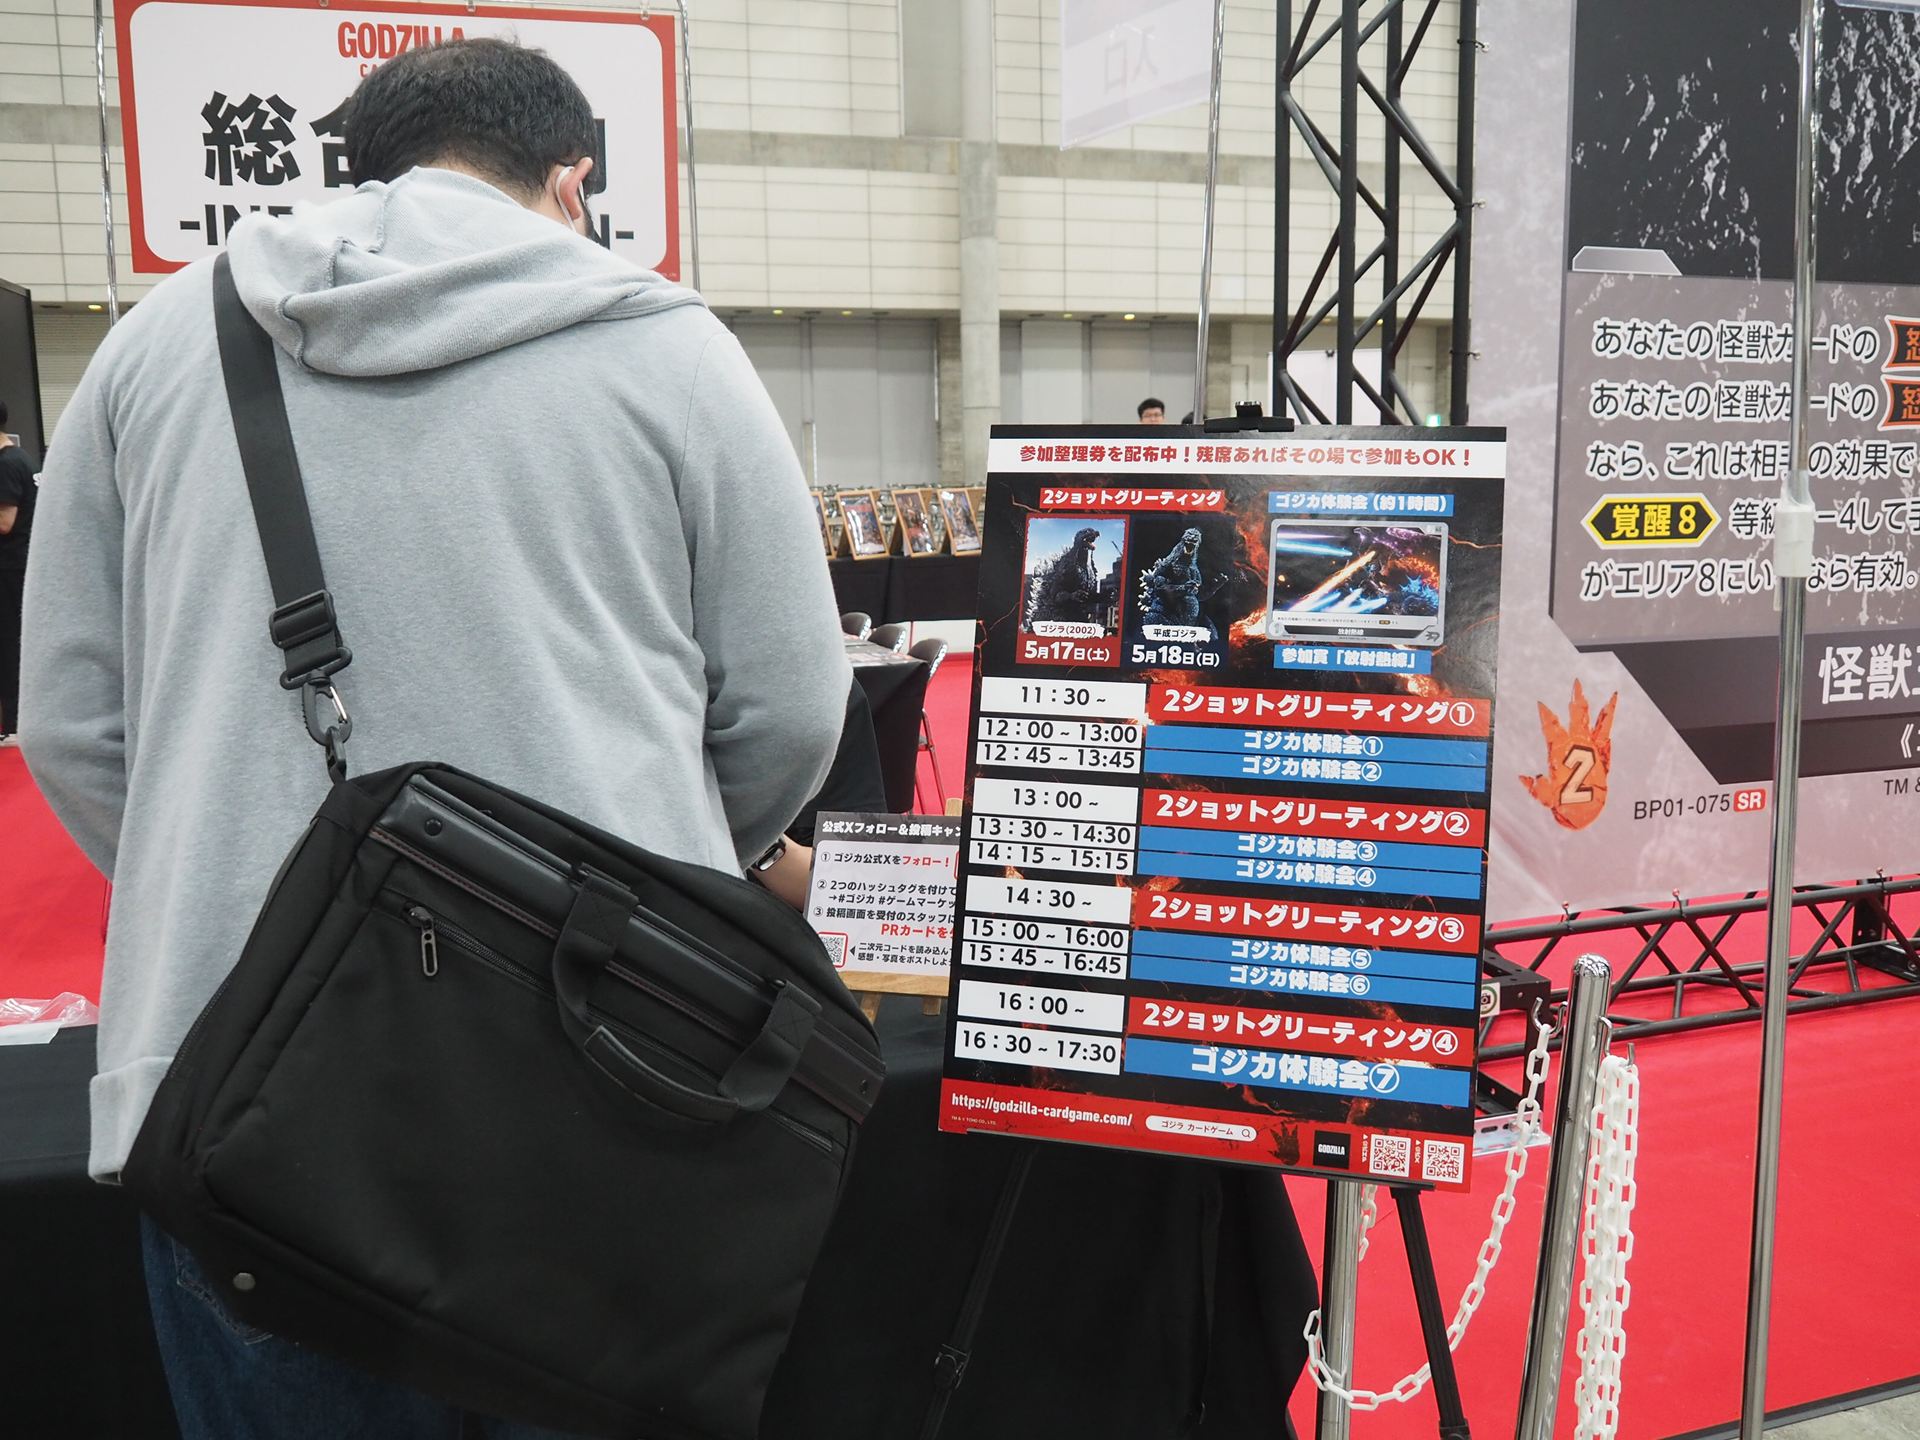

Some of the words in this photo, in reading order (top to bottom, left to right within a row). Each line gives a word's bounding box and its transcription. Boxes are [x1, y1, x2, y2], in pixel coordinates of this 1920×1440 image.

[1042, 489, 1222, 507] 2ショットグリーティング
[1611, 503, 1697, 538] 覚醒8
[1584, 555, 1916, 597] がエリア8にいなら有効。
[1040, 624, 1097, 636] ゴジラ(2002)
[1153, 628, 1198, 638] 平成ゴジラ
[1024, 640, 1110, 662] 5月17日(土)
[1131, 644, 1220, 667] 5月18日(日)
[1818, 642, 1920, 705] 怪獣
[1163, 689, 1475, 727] 2ショットグリーティング①
[1243, 730, 1384, 757] ゴジカ体験会①
[1242, 756, 1382, 782] ゴジカ体験会②
[1560, 744, 1597, 805] 2
[1884, 778, 1909, 795] TM
[1156, 794, 1470, 837] 2ショットグリーティング②
[1633, 793, 1731, 820] BP01-075
[1737, 790, 1762, 811] SR
[1237, 834, 1378, 862] ゴジカ体験会③
[1236, 860, 1377, 888] ゴジカ体験会④
[1149, 896, 1465, 943] 2ショットグリーティング③
[857, 952, 952, 966] 感想・写真をポストしよ
[858, 942, 952, 956] 二次元コードを読み込ん
[1231, 939, 1372, 970] ゴジカ体験会⑤
[1229, 966, 1371, 996] ゴジカ体験会⑥
[1142, 1003, 1458, 1056] 2ショットグリーティング④
[1191, 1047, 1400, 1094] ゴジカ体験会⑦
[951, 1093, 1133, 1127] https://godzilla-cardgame.com/
[1161, 1120, 1184, 1131] ゴジラ
[1187, 1122, 1234, 1136] カードゲーム
[1317, 1143, 1346, 1156] GODZILLA
